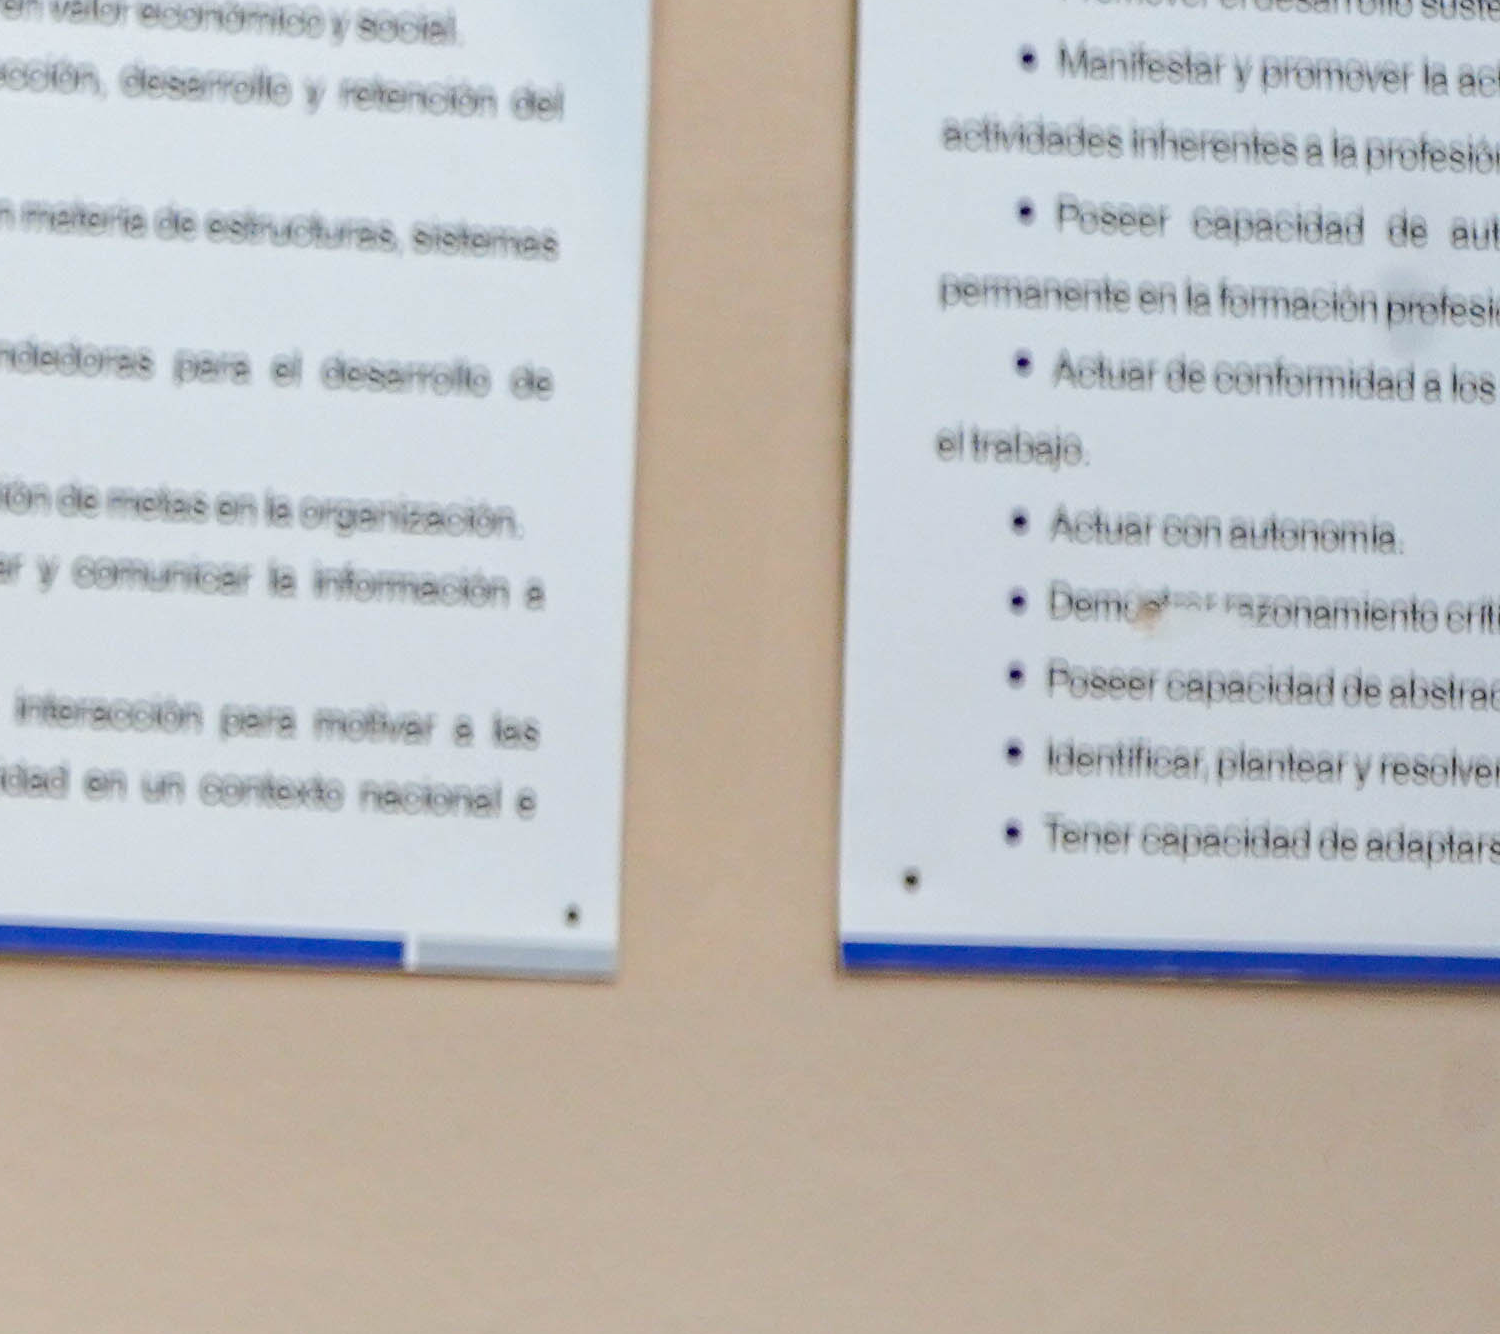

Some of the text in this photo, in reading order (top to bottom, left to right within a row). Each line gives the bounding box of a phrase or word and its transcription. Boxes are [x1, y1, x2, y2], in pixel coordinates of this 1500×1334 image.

[117, 59, 293, 108] desarrollo
[509, 81, 566, 124] del
[940, 110, 1124, 164] actividades
[1128, 119, 1298, 170] inherentes
[1303, 133, 1324, 168] a
[1330, 128, 1358, 171] la
[1053, 191, 1167, 240] Poseer
[1191, 196, 1366, 252] capacidad
[1386, 206, 1428, 251] de
[171, 348, 252, 390] para
[319, 351, 493, 399] desarrollo
[1052, 348, 1495, 409] Actuar de conformidad a los
[934, 422, 965, 463] el
[1049, 503, 1153, 549] Actuar
[1161, 512, 1223, 551] con
[1045, 656, 1157, 704] Poseer
[1164, 658, 1336, 713] capacidad
[1340, 667, 1382, 710] de
[216, 703, 298, 744] para
[311, 703, 436, 746] motivar
[489, 710, 541, 752] las
[1214, 741, 1345, 790] plantear
[1353, 753, 1372, 792] y
[1045, 811, 1132, 857] Tener
[1140, 813, 1313, 865] capacidad
[1318, 821, 1358, 863] de
